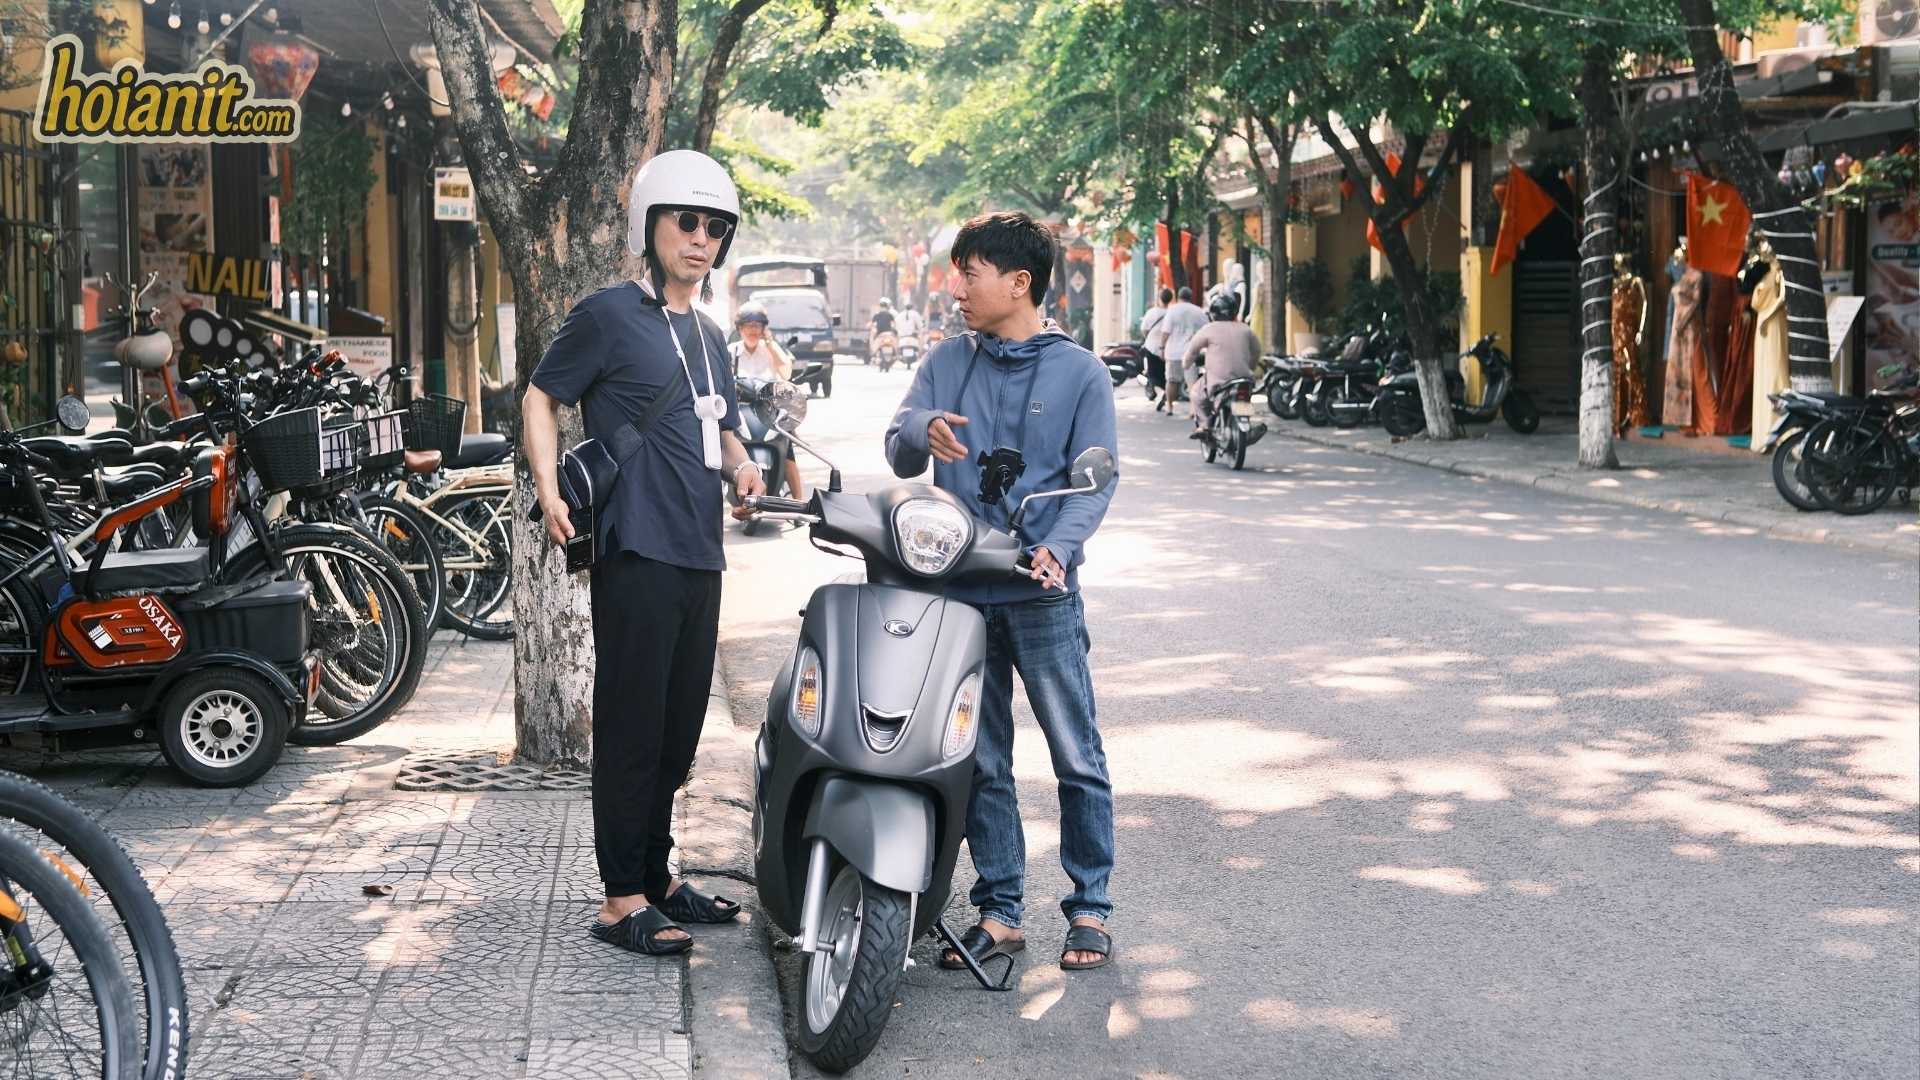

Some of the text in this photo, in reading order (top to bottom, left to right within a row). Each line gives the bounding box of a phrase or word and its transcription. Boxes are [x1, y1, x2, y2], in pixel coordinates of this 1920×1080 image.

[186, 254, 268, 300] NAIL
[330, 541, 388, 572] KENDA
[138, 597, 182, 649] OSAKA
